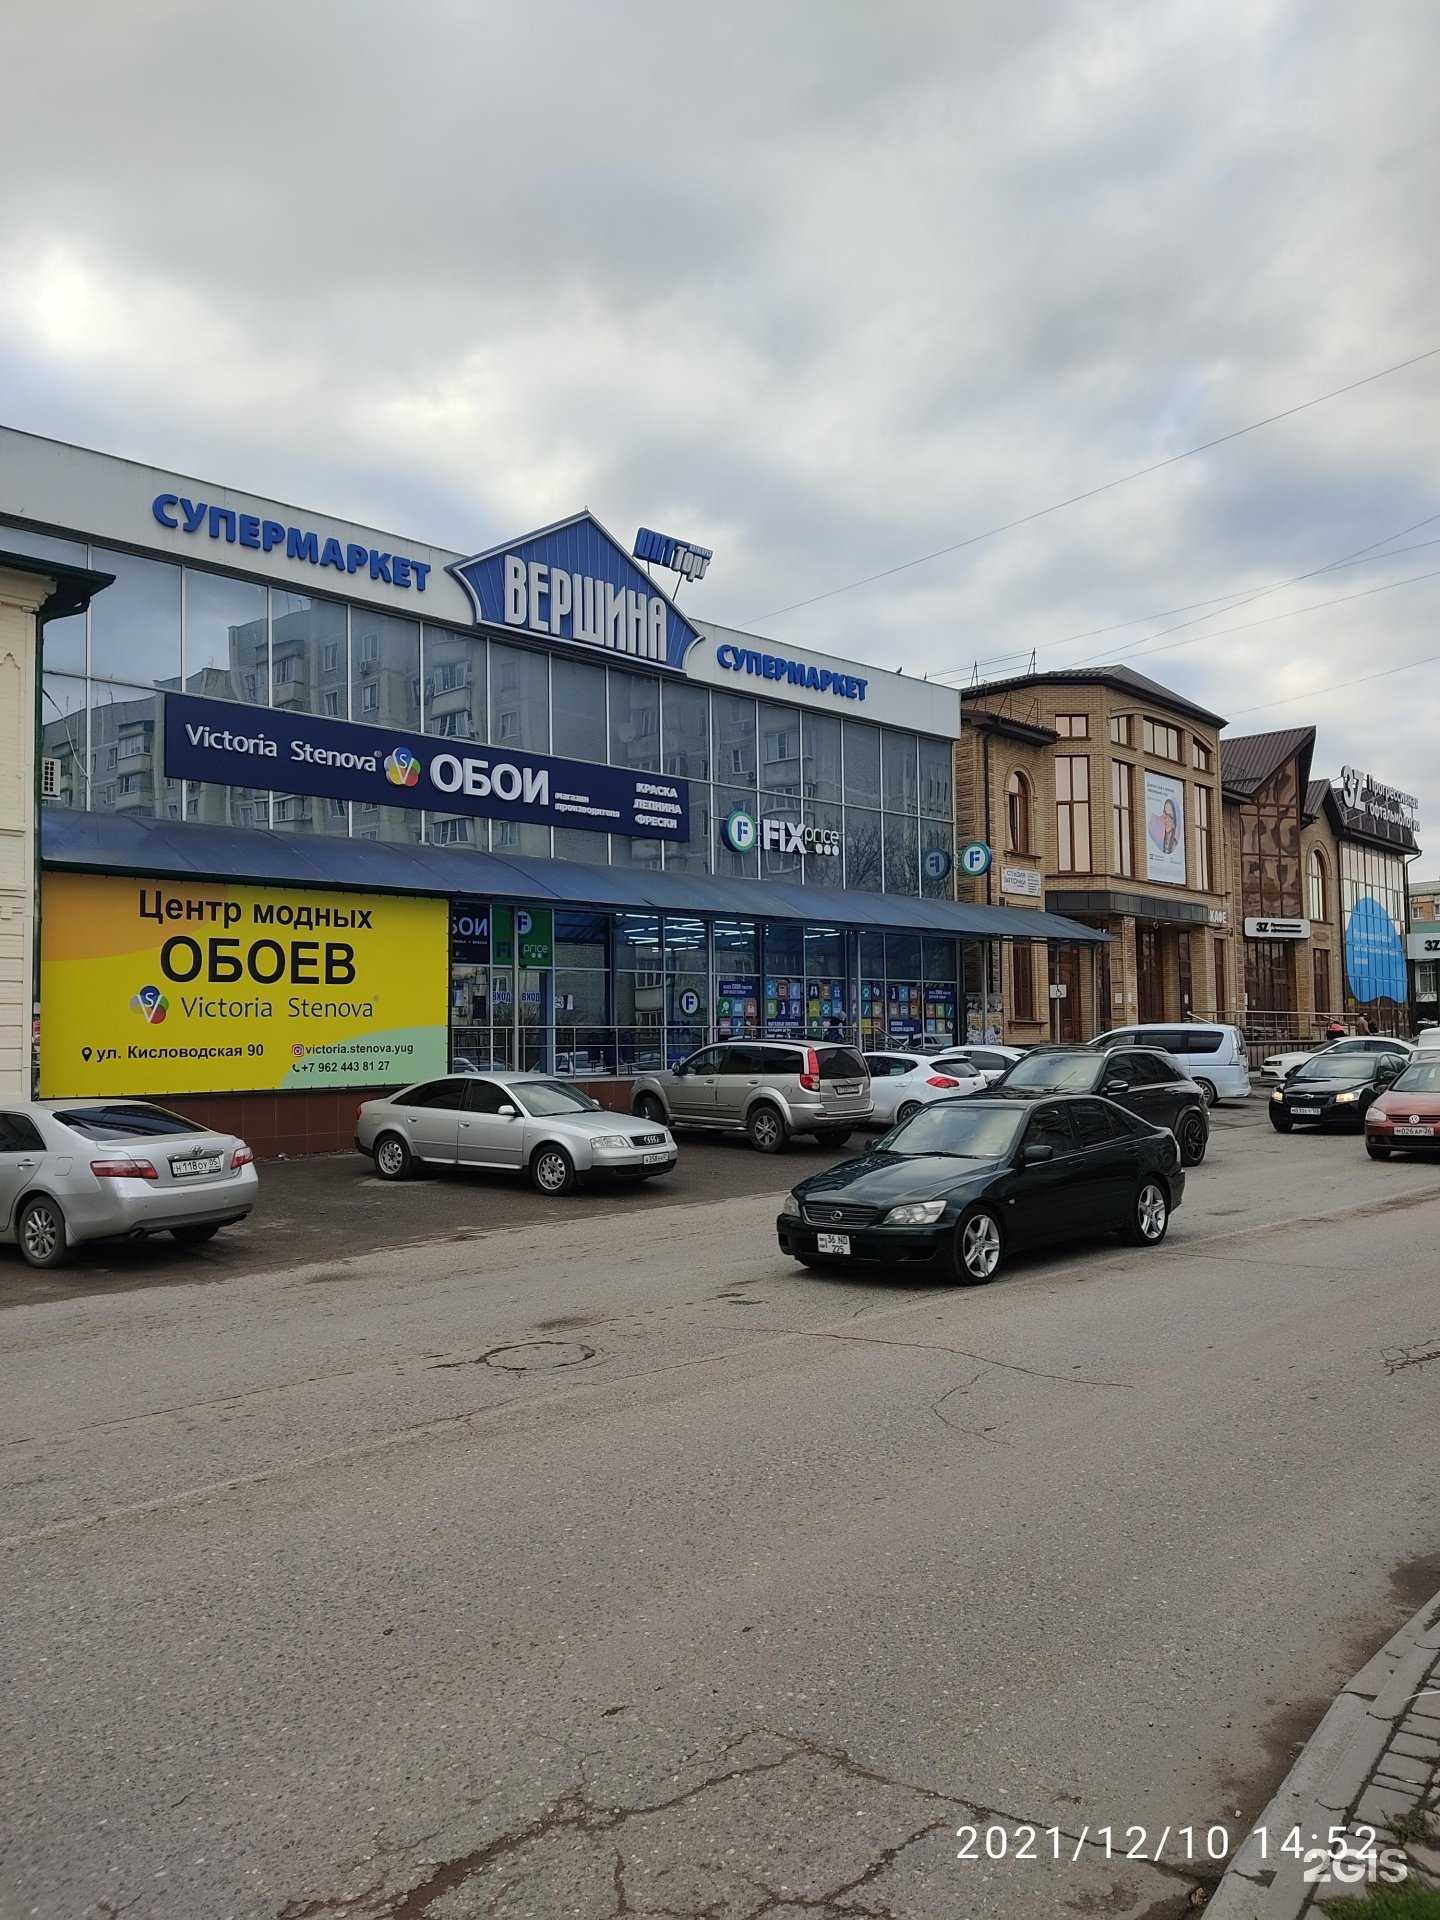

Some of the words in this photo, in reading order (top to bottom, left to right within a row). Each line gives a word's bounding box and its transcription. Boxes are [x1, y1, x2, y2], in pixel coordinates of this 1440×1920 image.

[152, 493, 431, 591] СУПЕРМАРКЕТ
[504, 554, 667, 662] ВЕРШИНА
[716, 644, 868, 701] СУПЕРМАРКЕТ
[185, 723, 278, 757] Victoria
[430, 754, 549, 806] ОБОИ
[636, 782, 679, 798] КРАСКА
[555, 802, 620, 818] производителя
[632, 798, 682, 815] ЛЕПНИНА
[634, 814, 678, 829] ФРЕСКИ
[139, 890, 242, 928] Центр
[253, 904, 373, 931] модных
[160, 936, 356, 985] ОБОЕВ
[181, 997, 273, 1018] Victoria
[96, 1049, 121, 1062] ул.
[128, 1045, 242, 1059] Кисловодская
[247, 1044, 264, 1057] 90
[305, 1044, 414, 1055] victoria.stenova.yug
[301, 1063, 316, 1073] +7
[318, 1062, 338, 1072] 962
[340, 1061, 360, 1071] 443
[362, 1061, 375, 1071] 81
[378, 1060, 391, 1070] 27
